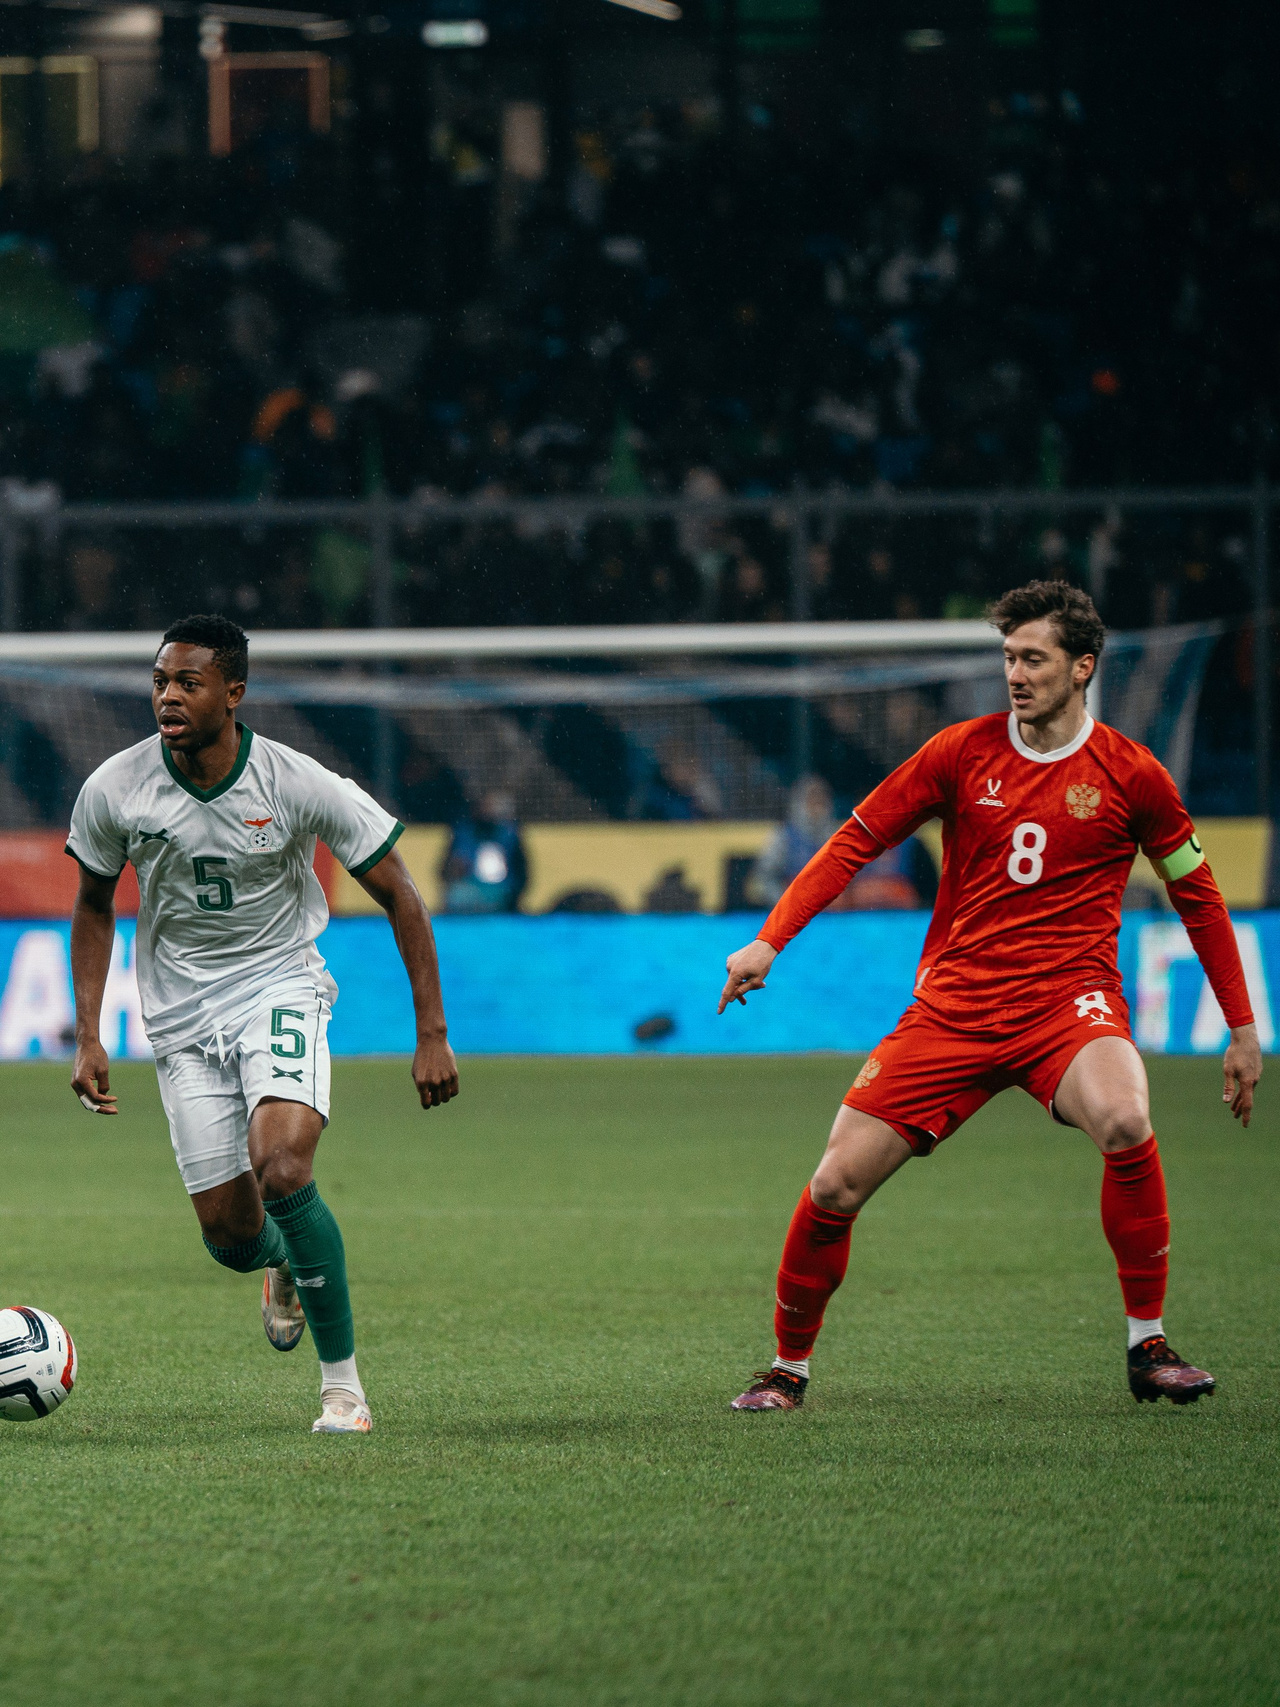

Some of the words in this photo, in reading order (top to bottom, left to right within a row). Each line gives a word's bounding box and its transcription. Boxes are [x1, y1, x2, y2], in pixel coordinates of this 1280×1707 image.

[1007, 821, 1047, 885] 8
[192, 856, 234, 911] 5
[270, 1008, 306, 1059] 5
